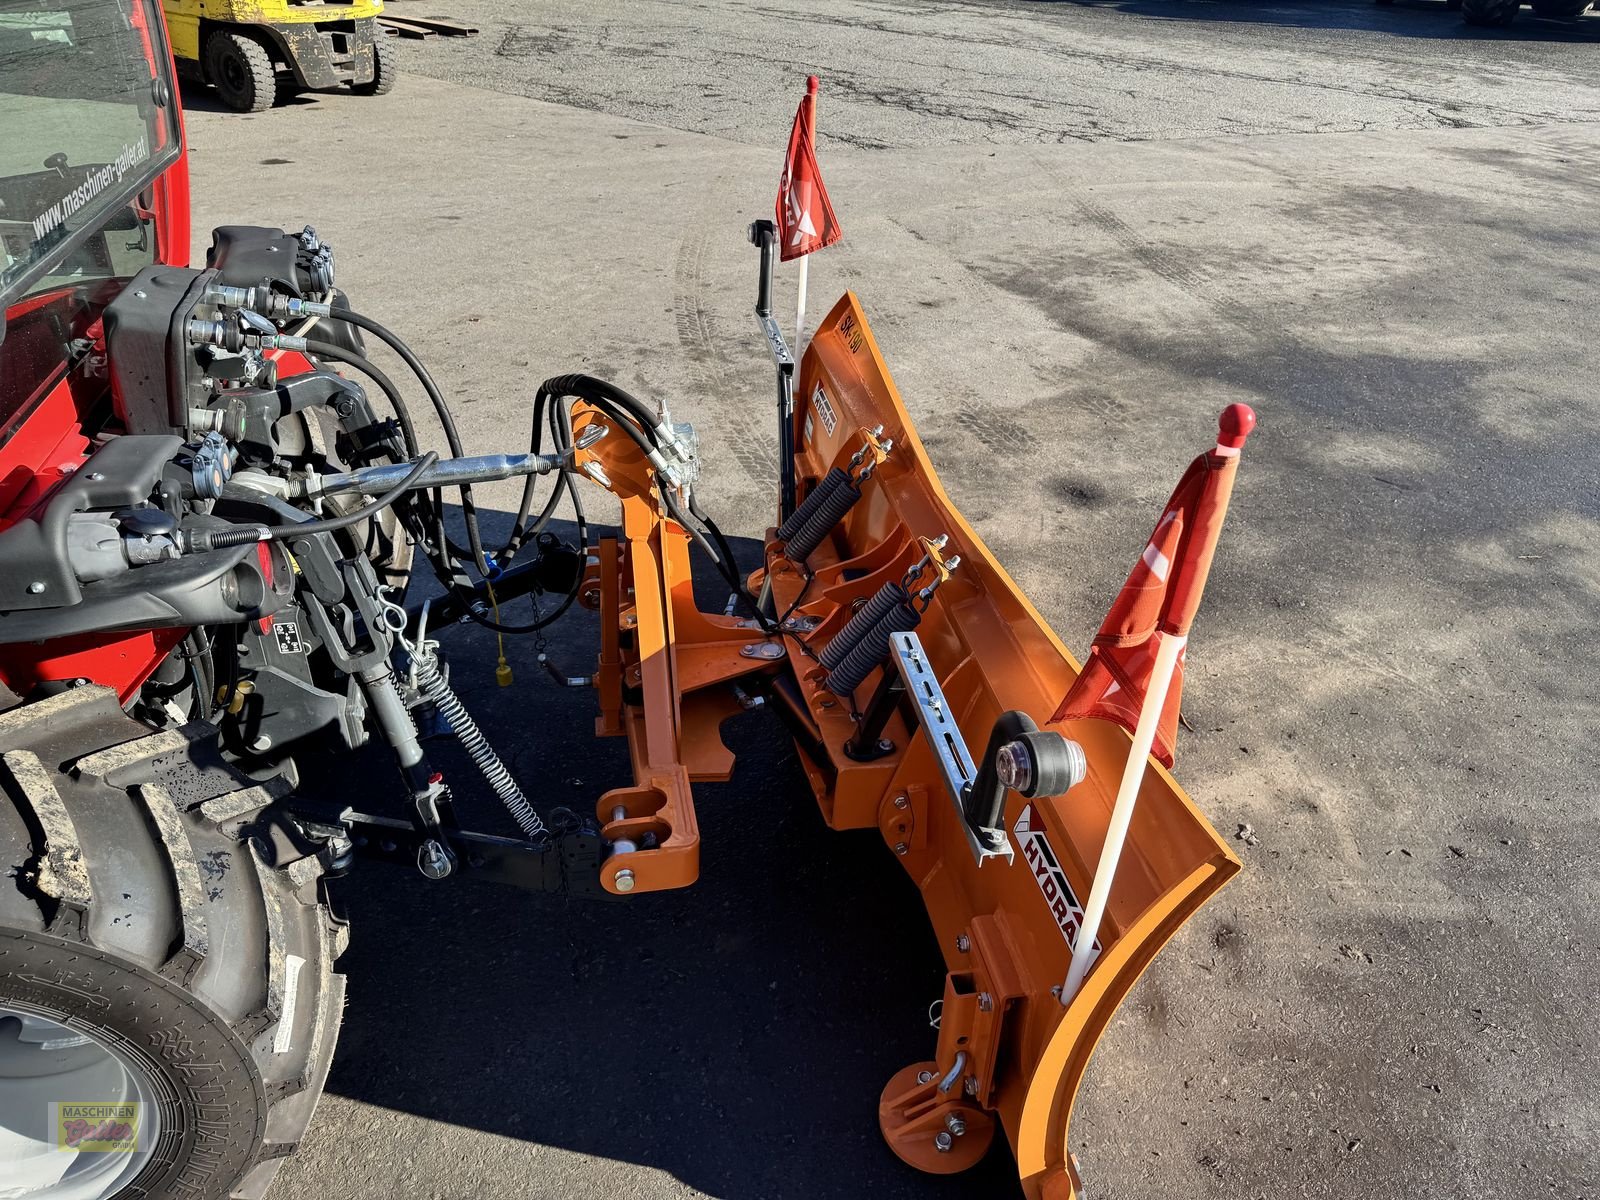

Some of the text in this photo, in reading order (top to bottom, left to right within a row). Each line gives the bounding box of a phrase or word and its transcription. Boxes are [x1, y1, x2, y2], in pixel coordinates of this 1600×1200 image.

[33, 136, 146, 240] www.maschinen-gailer.at
[841, 315, 862, 354] SK-190
[814, 394, 833, 434] HYDRAC
[1023, 837, 1078, 951] HYDRA
